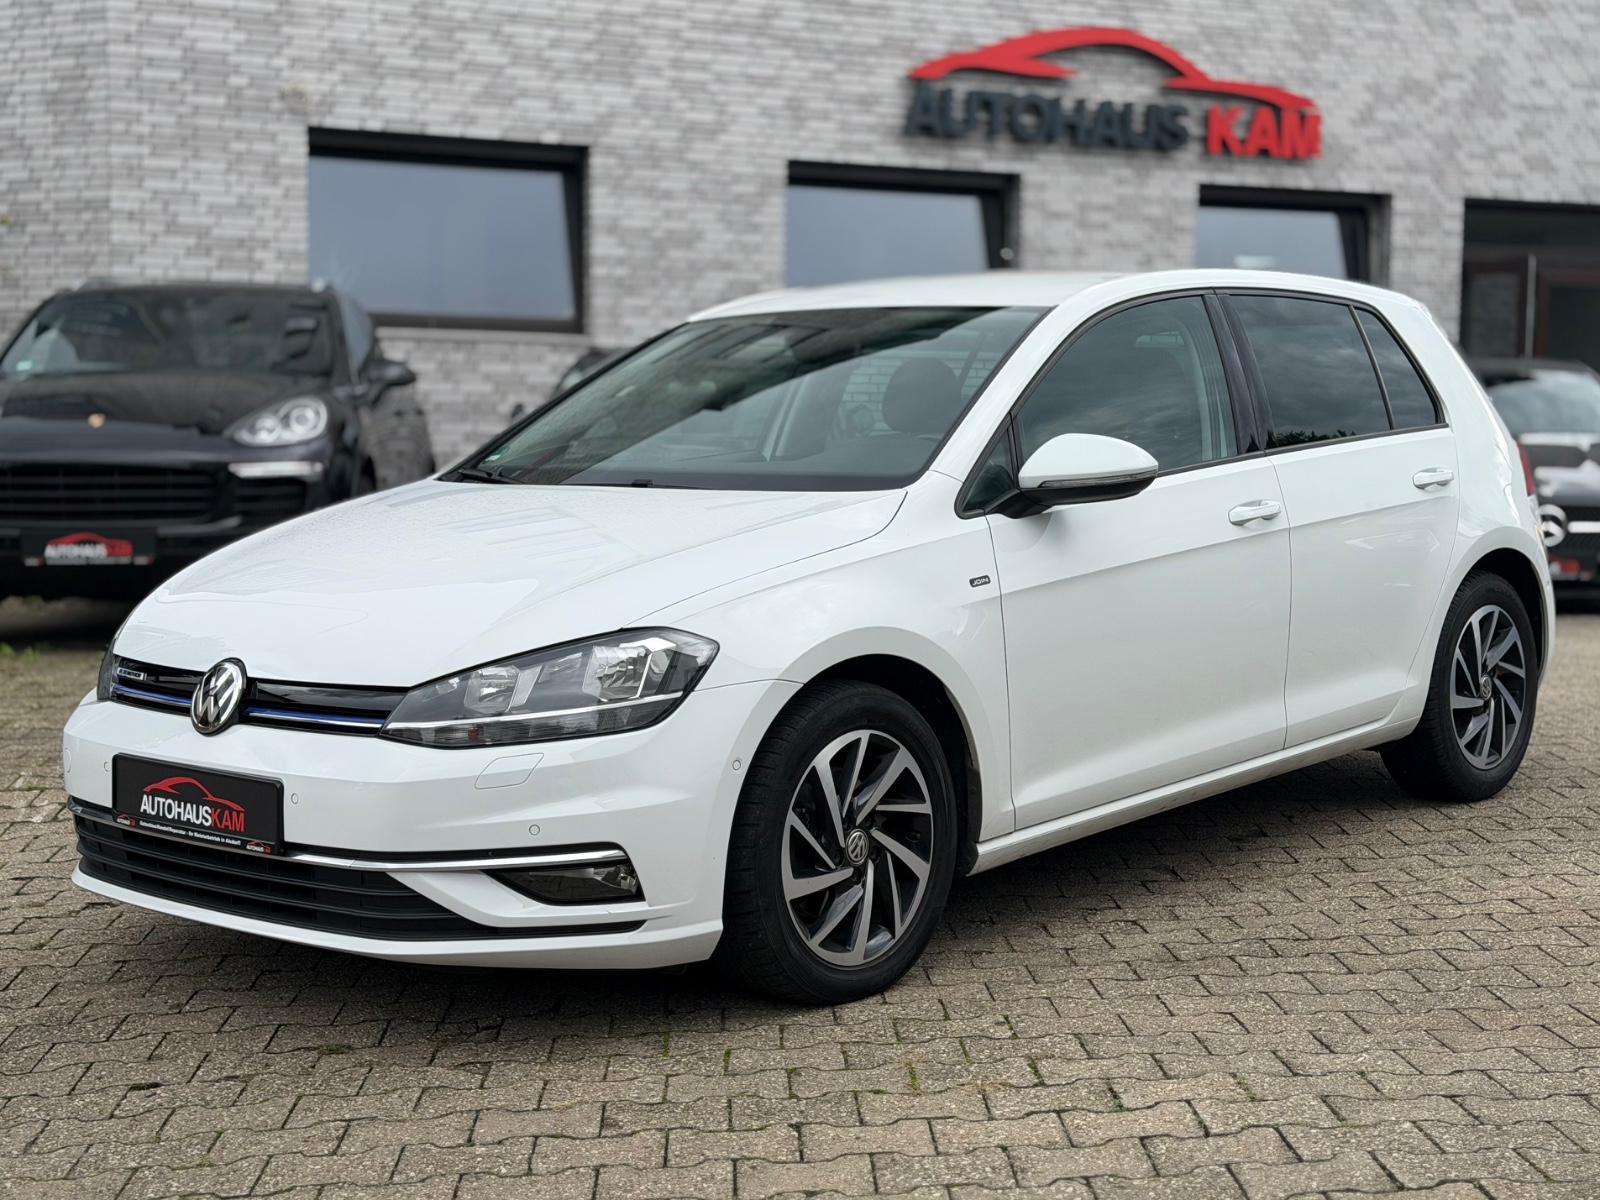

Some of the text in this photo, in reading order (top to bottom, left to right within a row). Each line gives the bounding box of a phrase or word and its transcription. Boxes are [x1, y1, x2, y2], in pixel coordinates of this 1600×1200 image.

[907, 87, 1321, 159] AUTOHAUS KAM
[972, 577, 989, 586] JOIN
